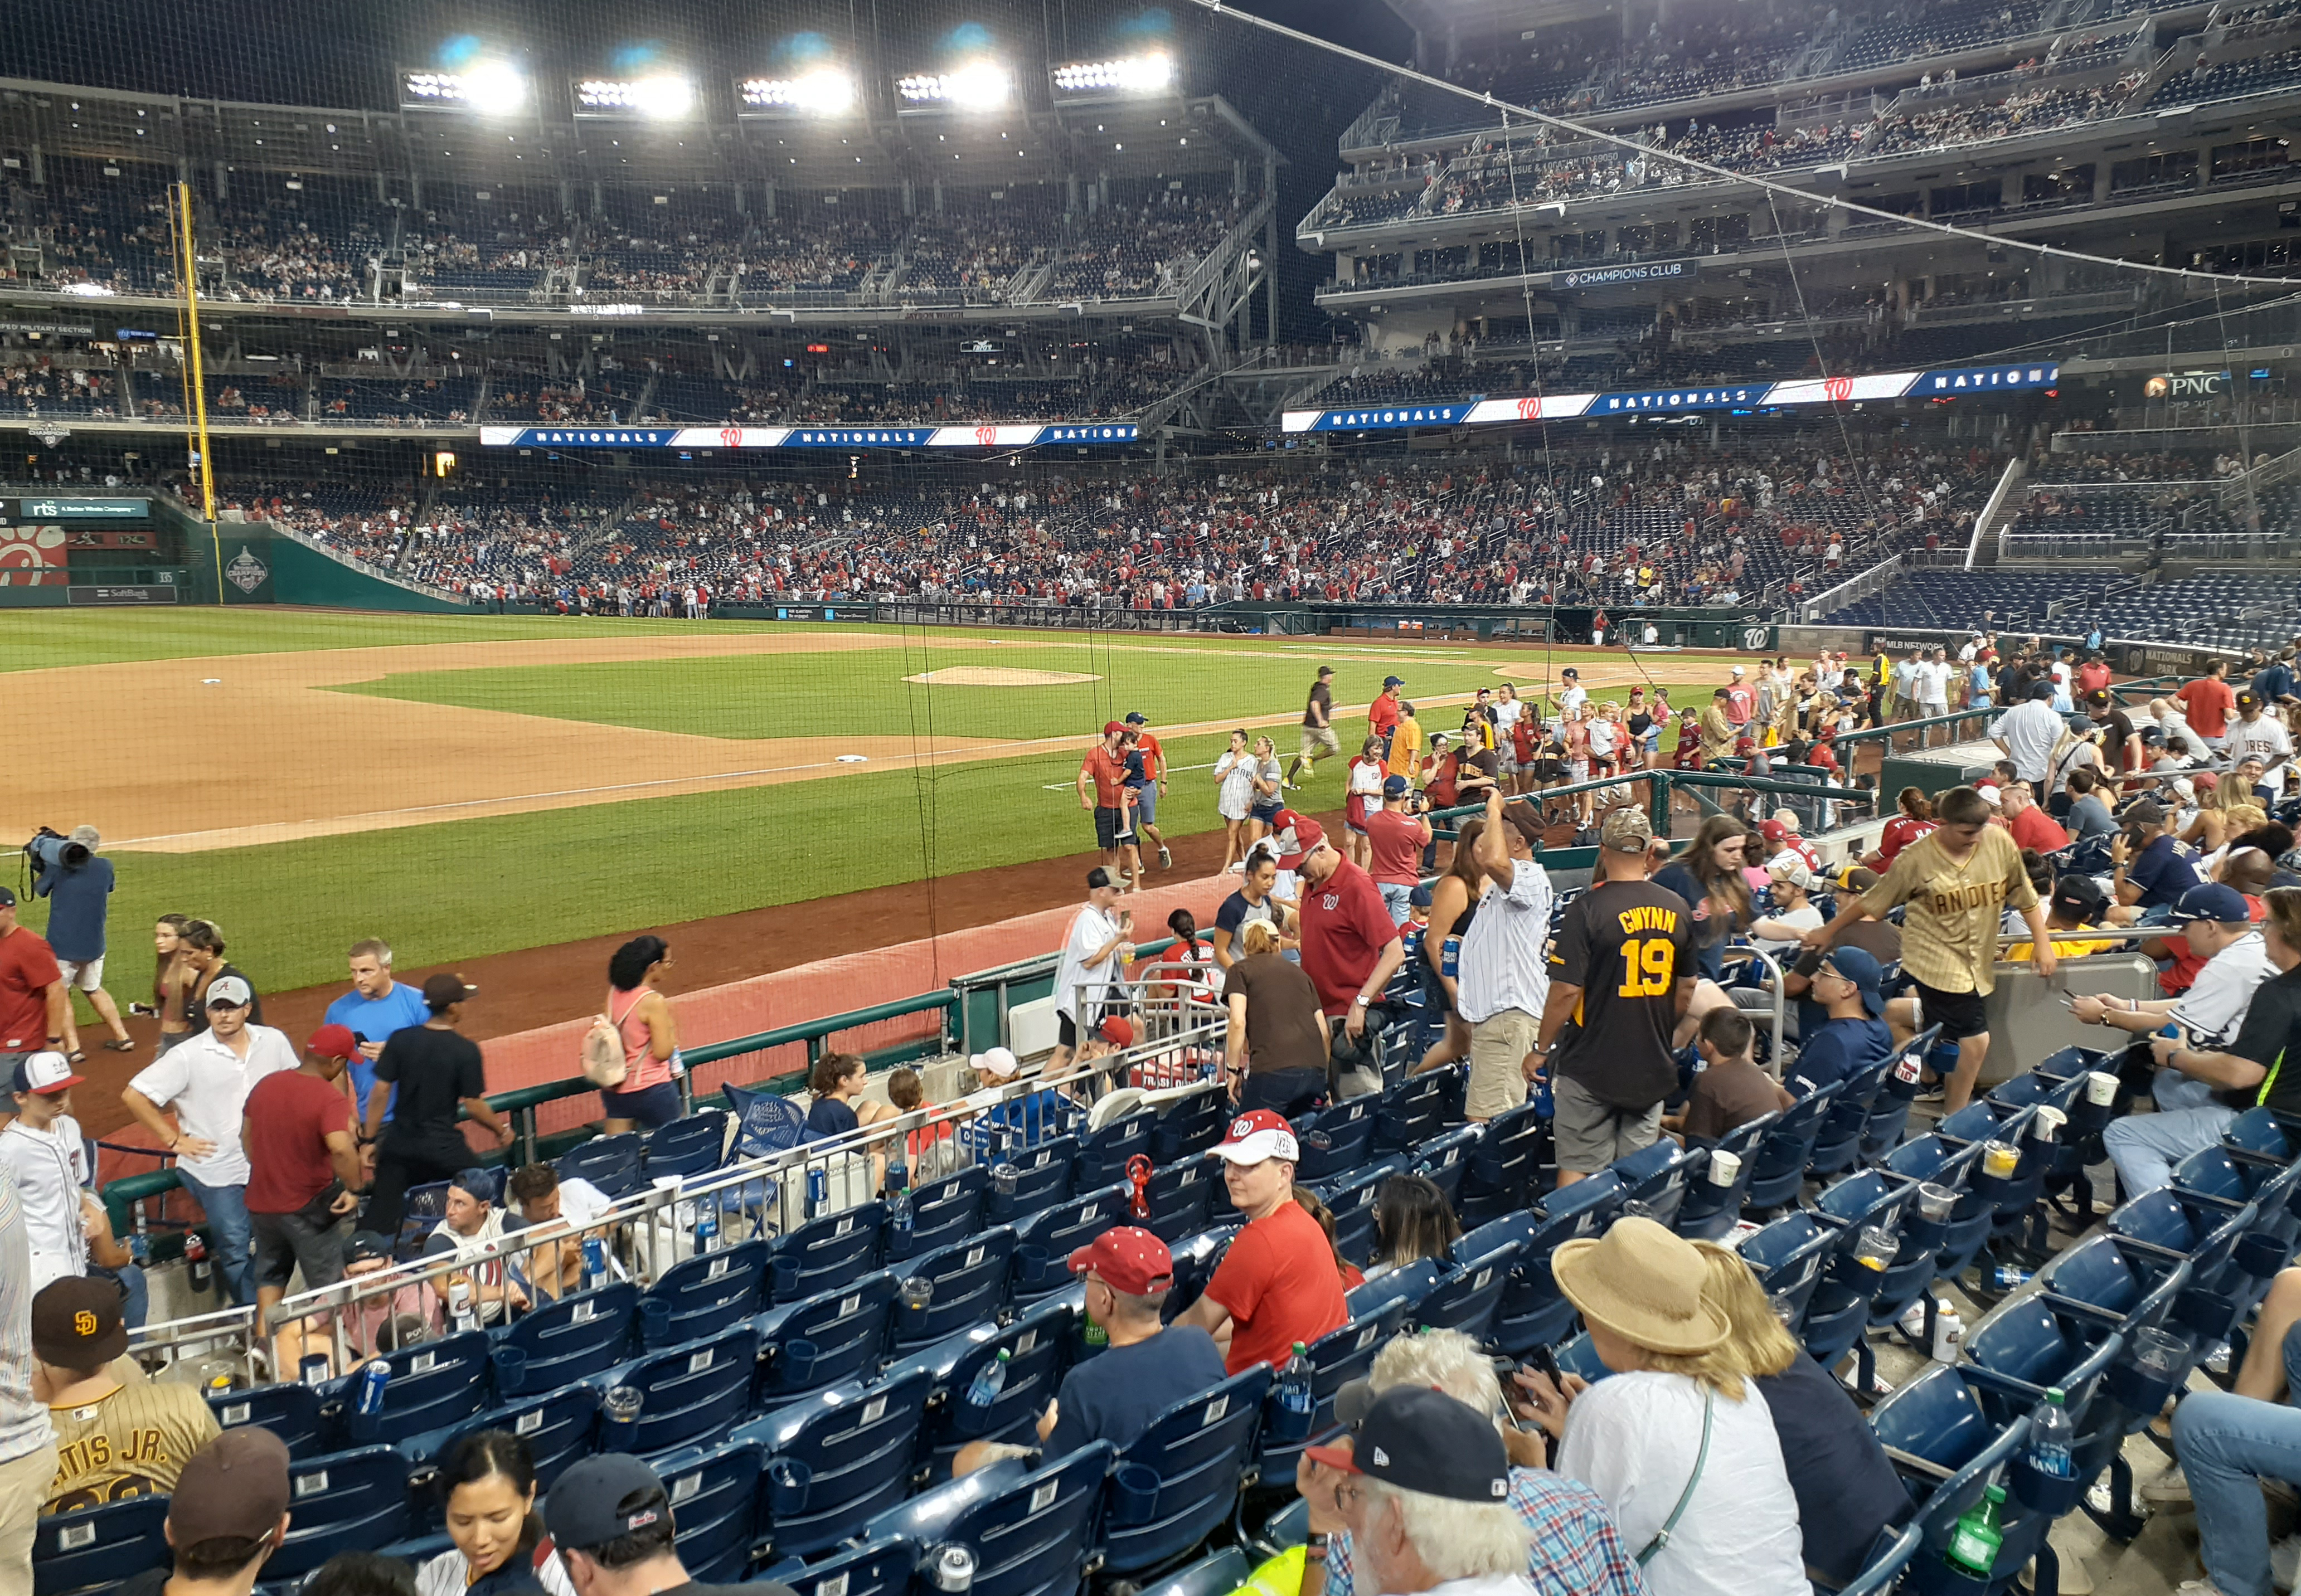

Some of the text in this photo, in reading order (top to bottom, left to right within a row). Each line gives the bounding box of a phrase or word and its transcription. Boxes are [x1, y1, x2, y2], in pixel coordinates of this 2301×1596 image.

[1579, 264, 1682, 284] CHAMPIONS CLUB
[2171, 376, 2221, 395] PNC
[1609, 390, 1747, 409] NATIONALS
[1333, 409, 1451, 425] NATIONALS
[537, 431, 658, 443] NATIONALS
[803, 431, 916, 443] NATIONALS
[33, 503, 58, 516] rts
[1744, 627, 1770, 650] W
[1887, 641, 1945, 651] MLB NETWORK
[2145, 649, 2192, 665] NATIONALS
[2157, 664, 2177, 676] PARK
[1323, 893, 1339, 910] W
[1618, 906, 1677, 935] GWYNN
[1618, 938, 1675, 997] 19
[216, 981, 230, 992] A
[1231, 1119, 1253, 1137] W
[75, 1310, 97, 1336] SD
[121, 1428, 167, 1462] JR.
